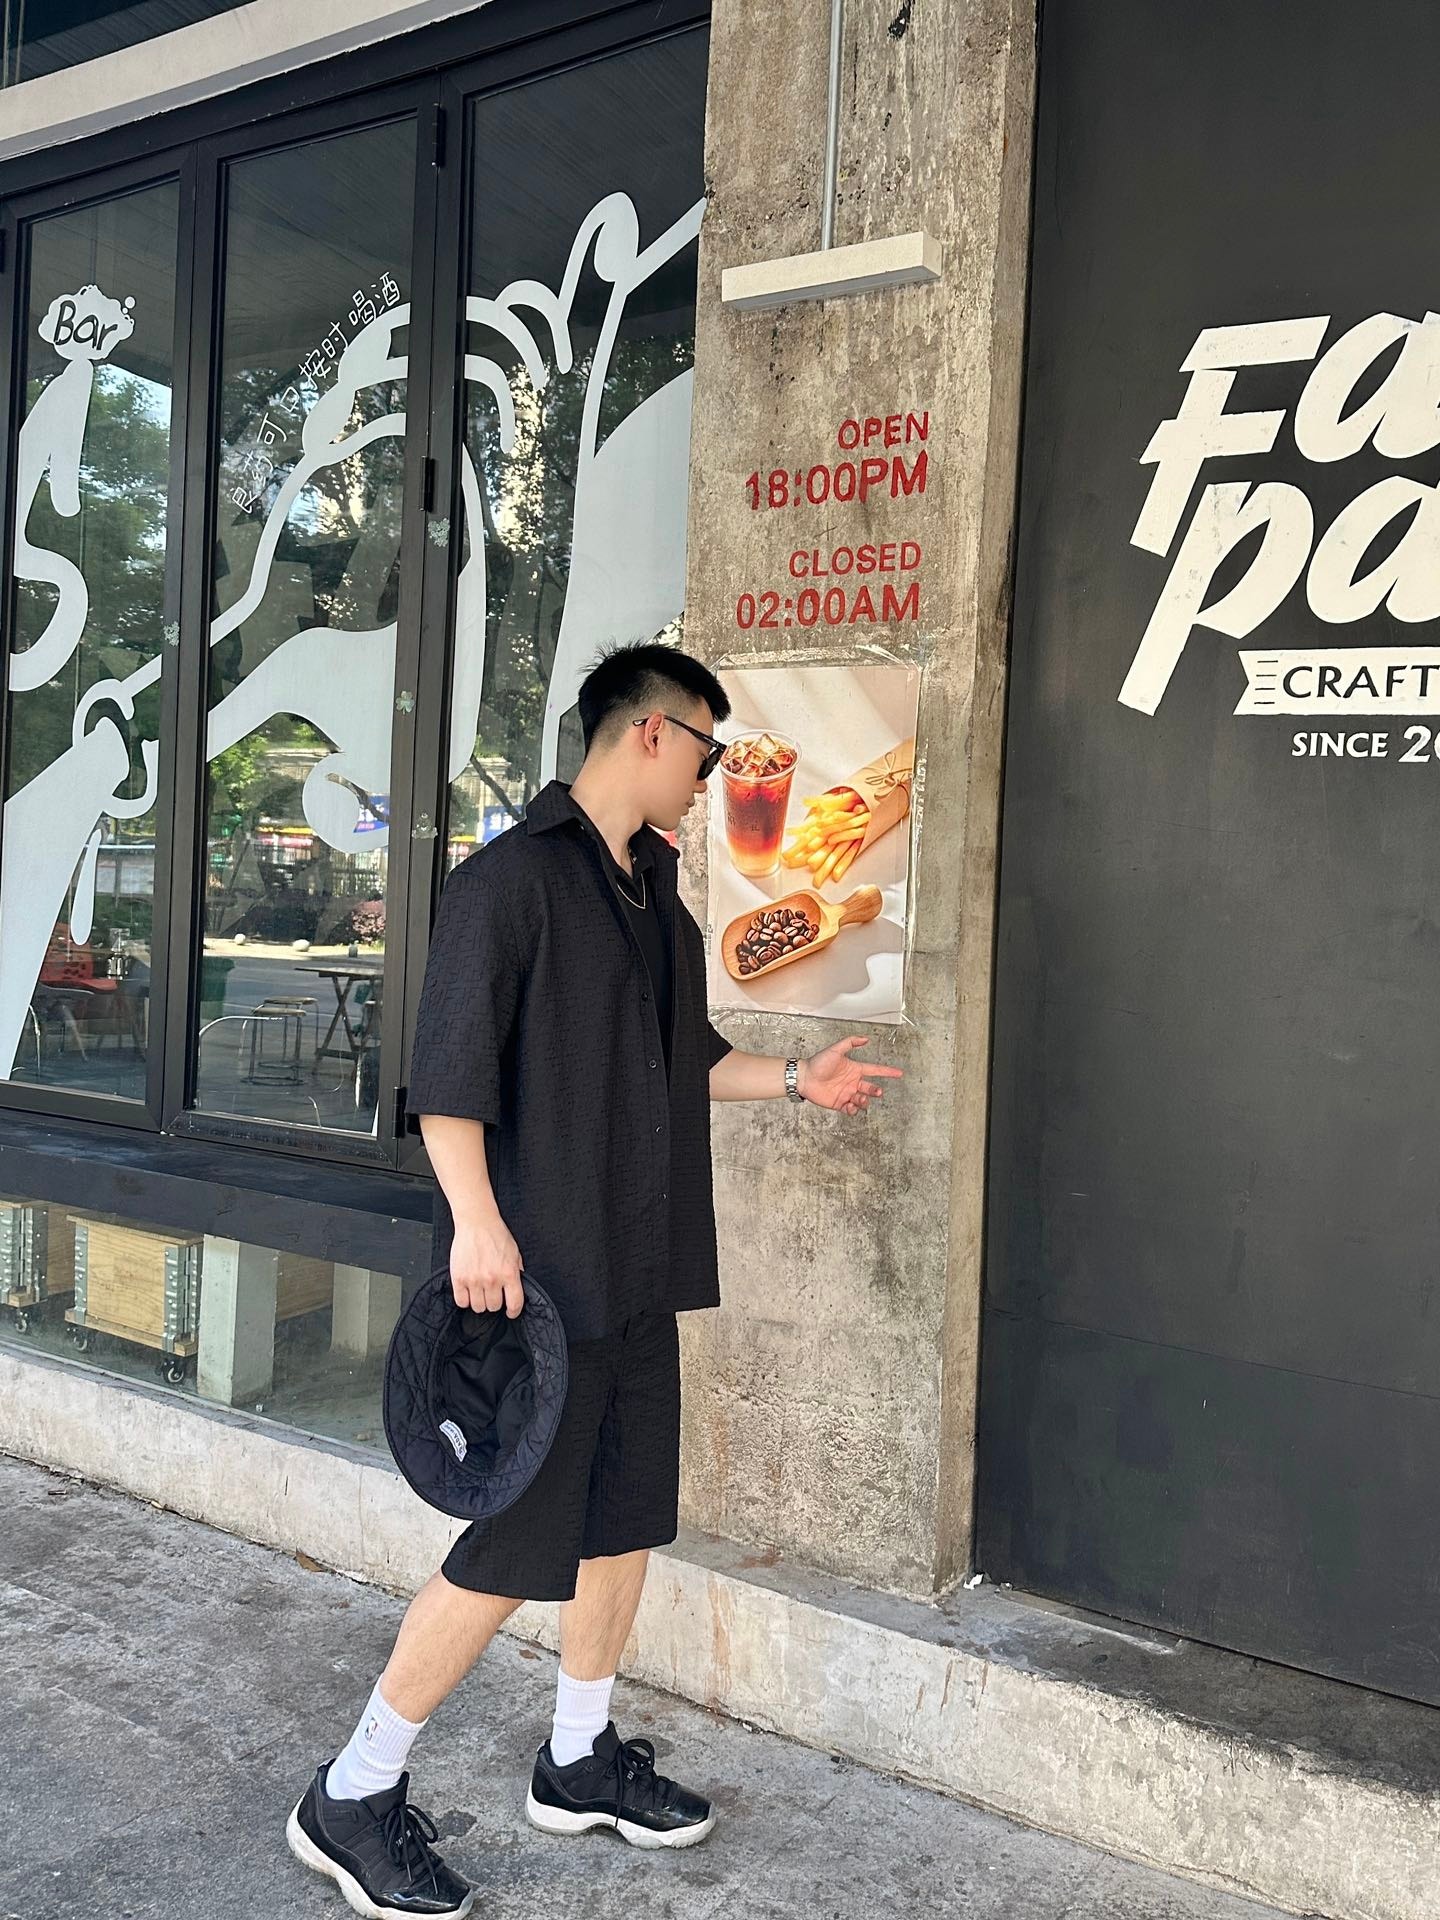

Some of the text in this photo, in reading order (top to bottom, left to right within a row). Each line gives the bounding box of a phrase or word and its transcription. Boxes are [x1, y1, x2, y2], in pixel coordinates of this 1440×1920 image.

[53, 300, 118, 350] Bar
[838, 411, 929, 450] OPEN
[745, 449, 929, 510] 18:00PM
[788, 541, 922, 577] CLOSED
[736, 582, 920, 629] 02:00AM
[1283, 665, 1440, 698] CRAFT
[1291, 725, 1440, 763] SINCE 2
